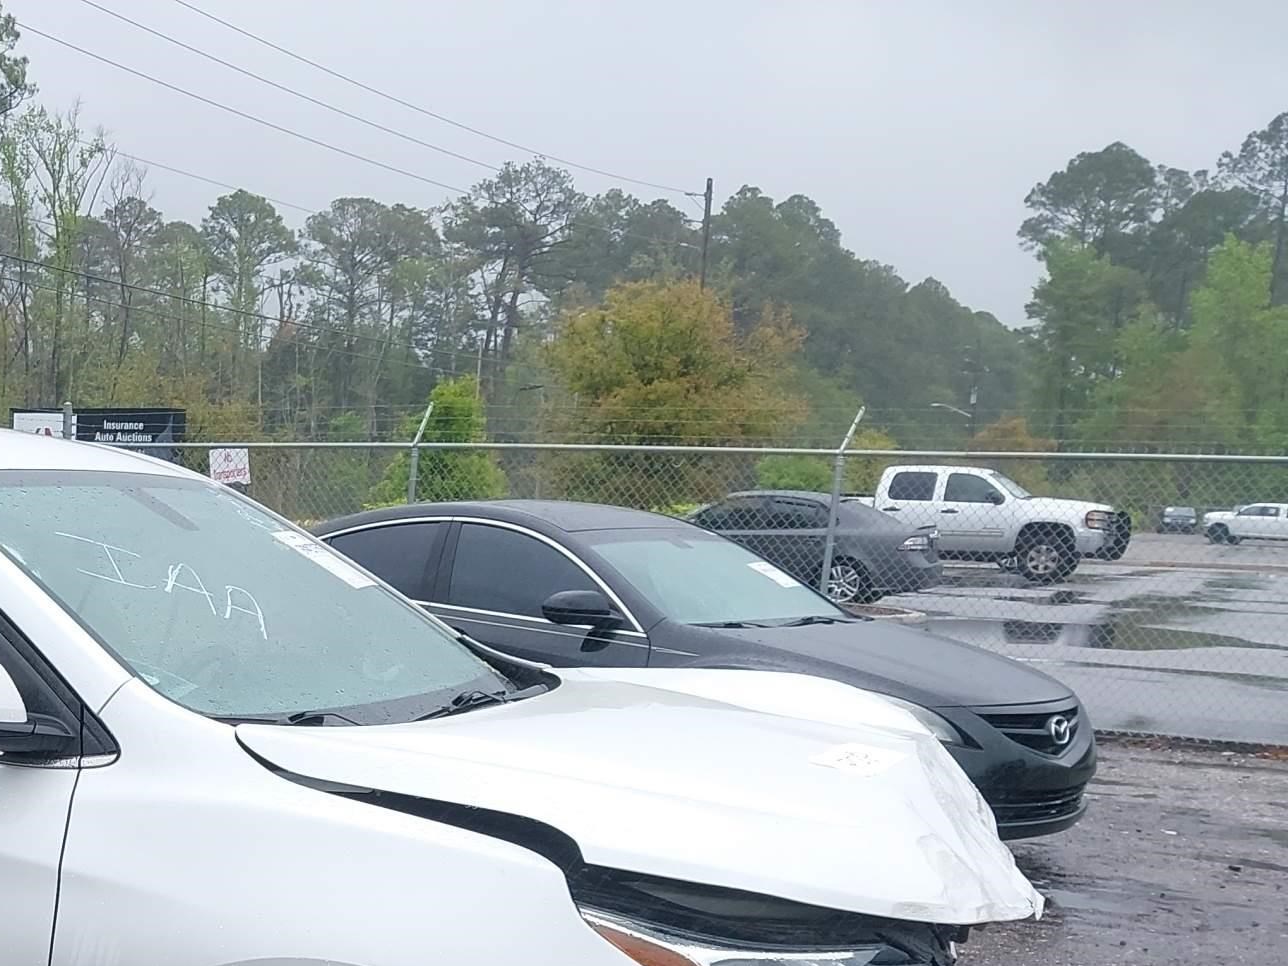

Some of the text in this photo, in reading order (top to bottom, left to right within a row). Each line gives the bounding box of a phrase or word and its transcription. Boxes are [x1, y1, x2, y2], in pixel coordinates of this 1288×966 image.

[103, 420, 144, 430] Insurance
[94, 431, 153, 442] Auto Auctions
[55, 531, 268, 640] IAA
